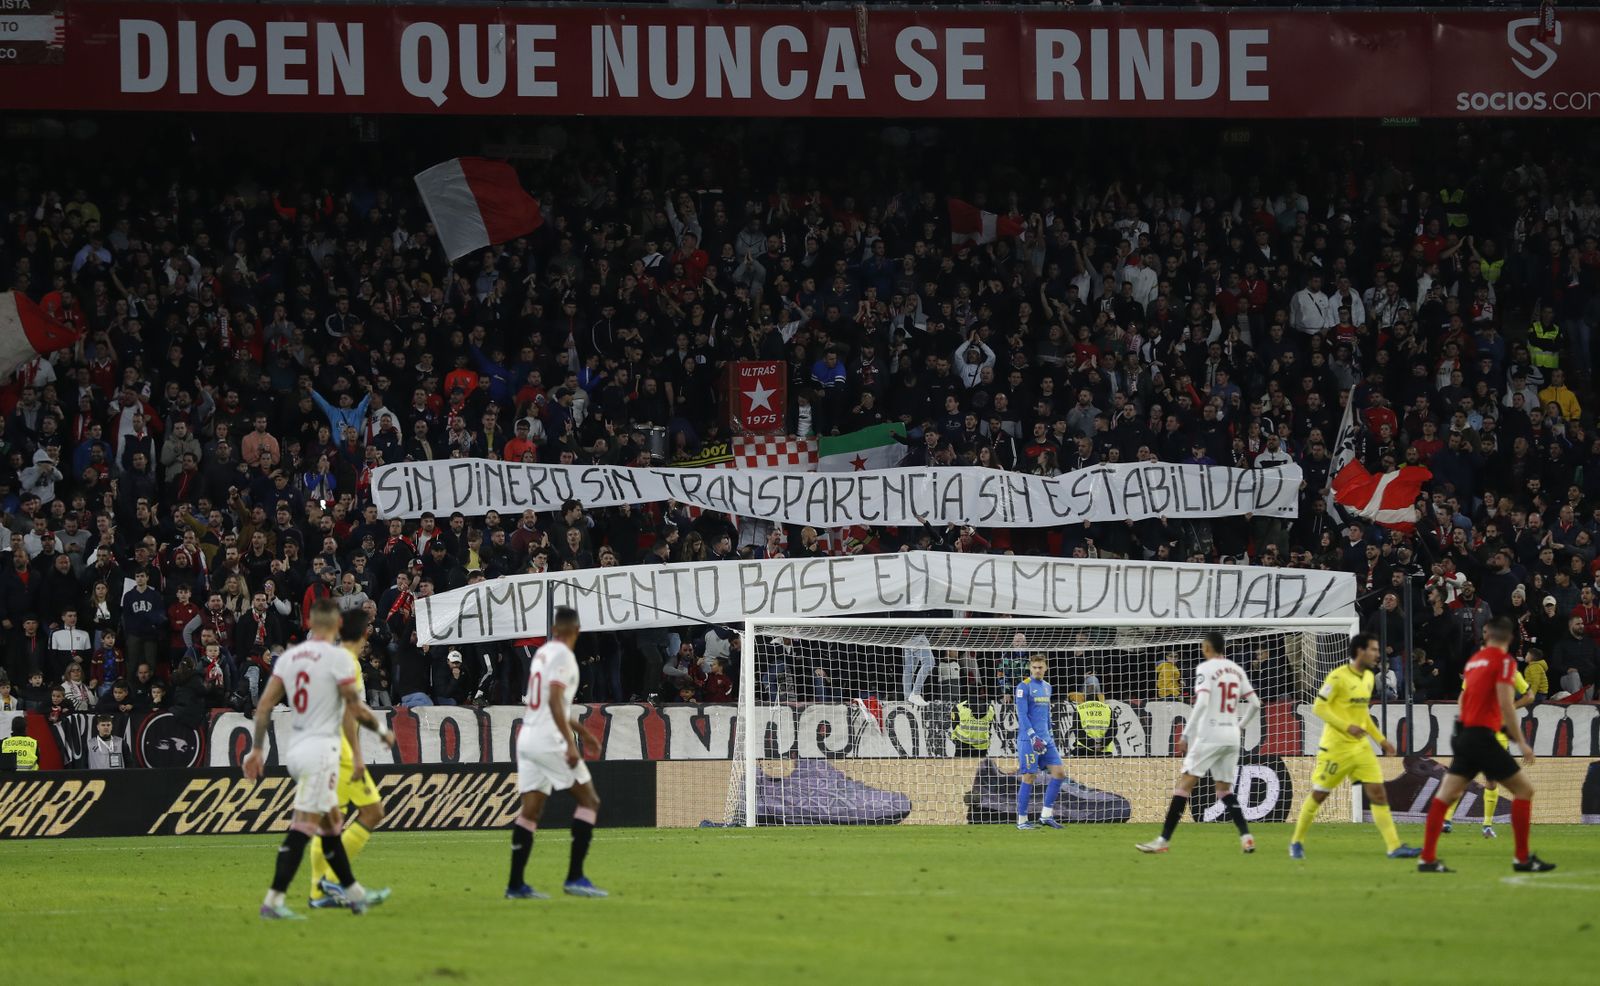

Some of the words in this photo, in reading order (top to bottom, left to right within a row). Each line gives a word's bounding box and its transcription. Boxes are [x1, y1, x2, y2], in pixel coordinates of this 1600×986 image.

[0, 0, 31, 9] ISTA
[119, 19, 365, 96] DICEN
[400, 22, 558, 107] QUE
[591, 24, 866, 100] NUNCA
[894, 26, 987, 101] SE
[1035, 27, 1270, 101] RINDE
[741, 365, 777, 377] ULTRAS
[746, 414, 776, 425] 1975
[738, 557, 857, 615] BASE
[874, 553, 930, 606] EN
[946, 553, 996, 609] LA
[293, 671, 310, 714] 6
[1217, 681, 1238, 713] 15
[1025, 754, 1036, 764] 13
[1325, 760, 1338, 776] 10
